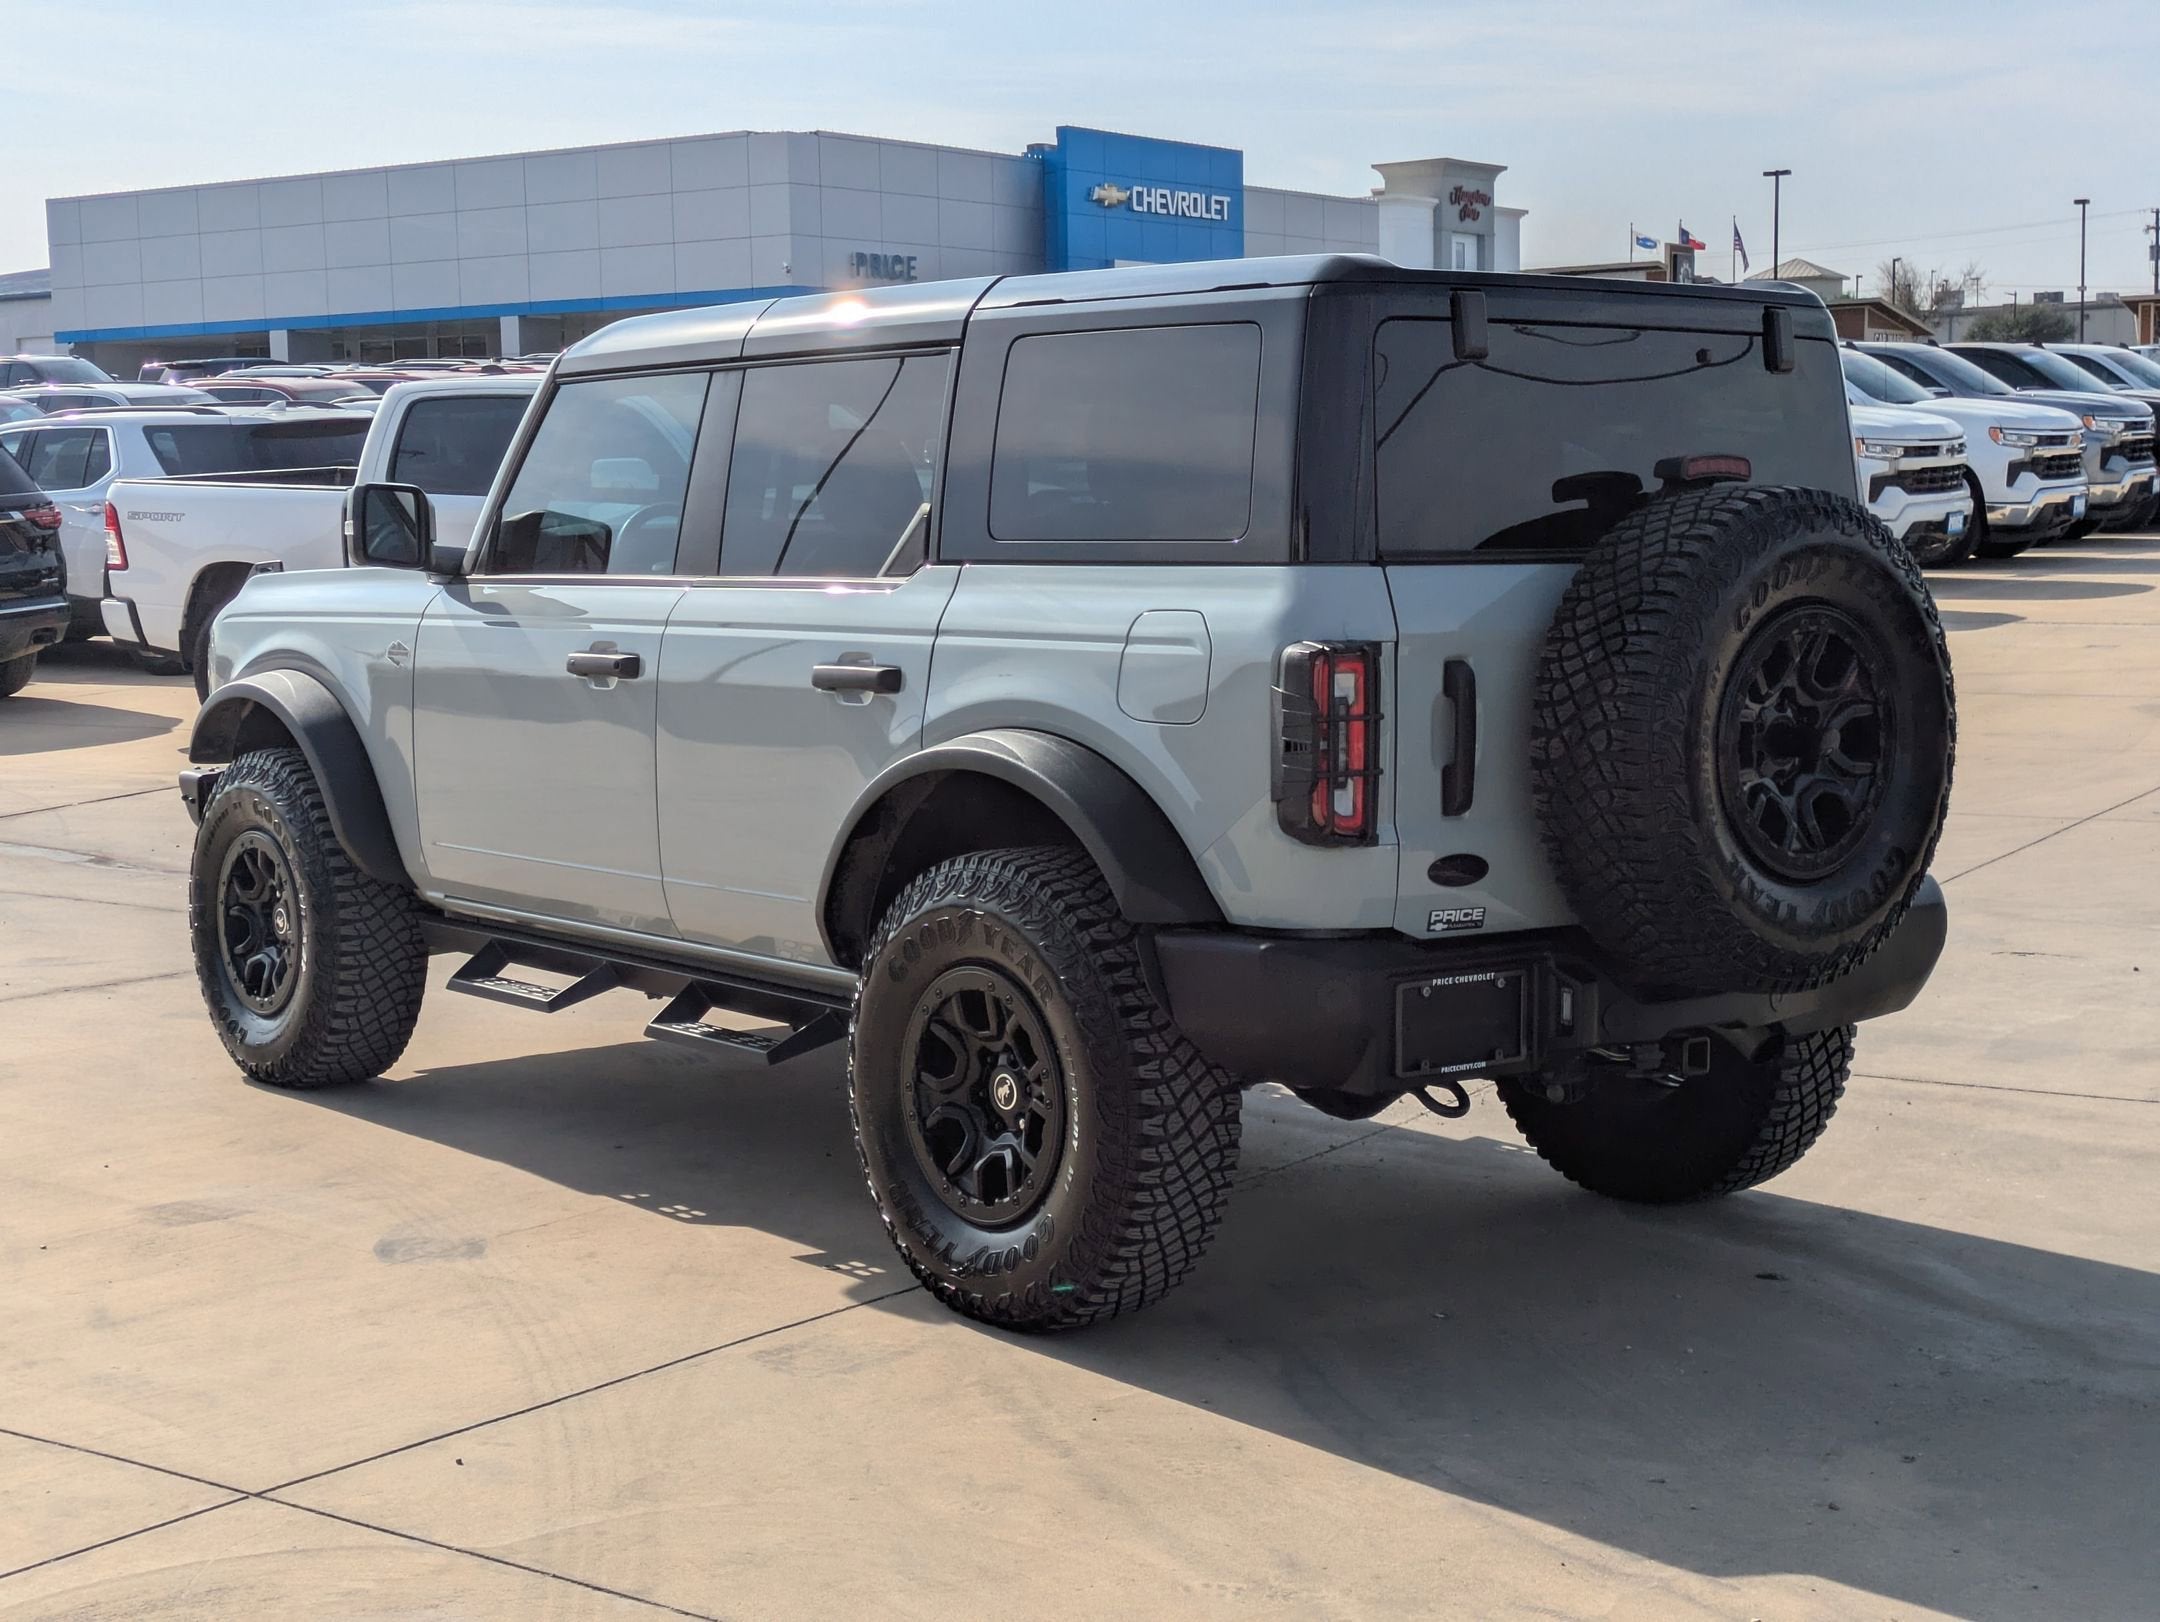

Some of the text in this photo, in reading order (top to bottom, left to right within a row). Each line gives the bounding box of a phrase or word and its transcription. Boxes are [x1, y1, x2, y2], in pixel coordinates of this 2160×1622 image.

[1132, 186, 1231, 221] CHEVROLET
[855, 252, 918, 282] PRICE
[127, 511, 186, 522] SPORT
[1430, 908, 1485, 923] PRICE
[887, 908, 1055, 1008] GOODYEAR
[1432, 972, 1496, 987] PRICE CHEVROLET
[1440, 1061, 1487, 1074] PRICECHEVY.COM
